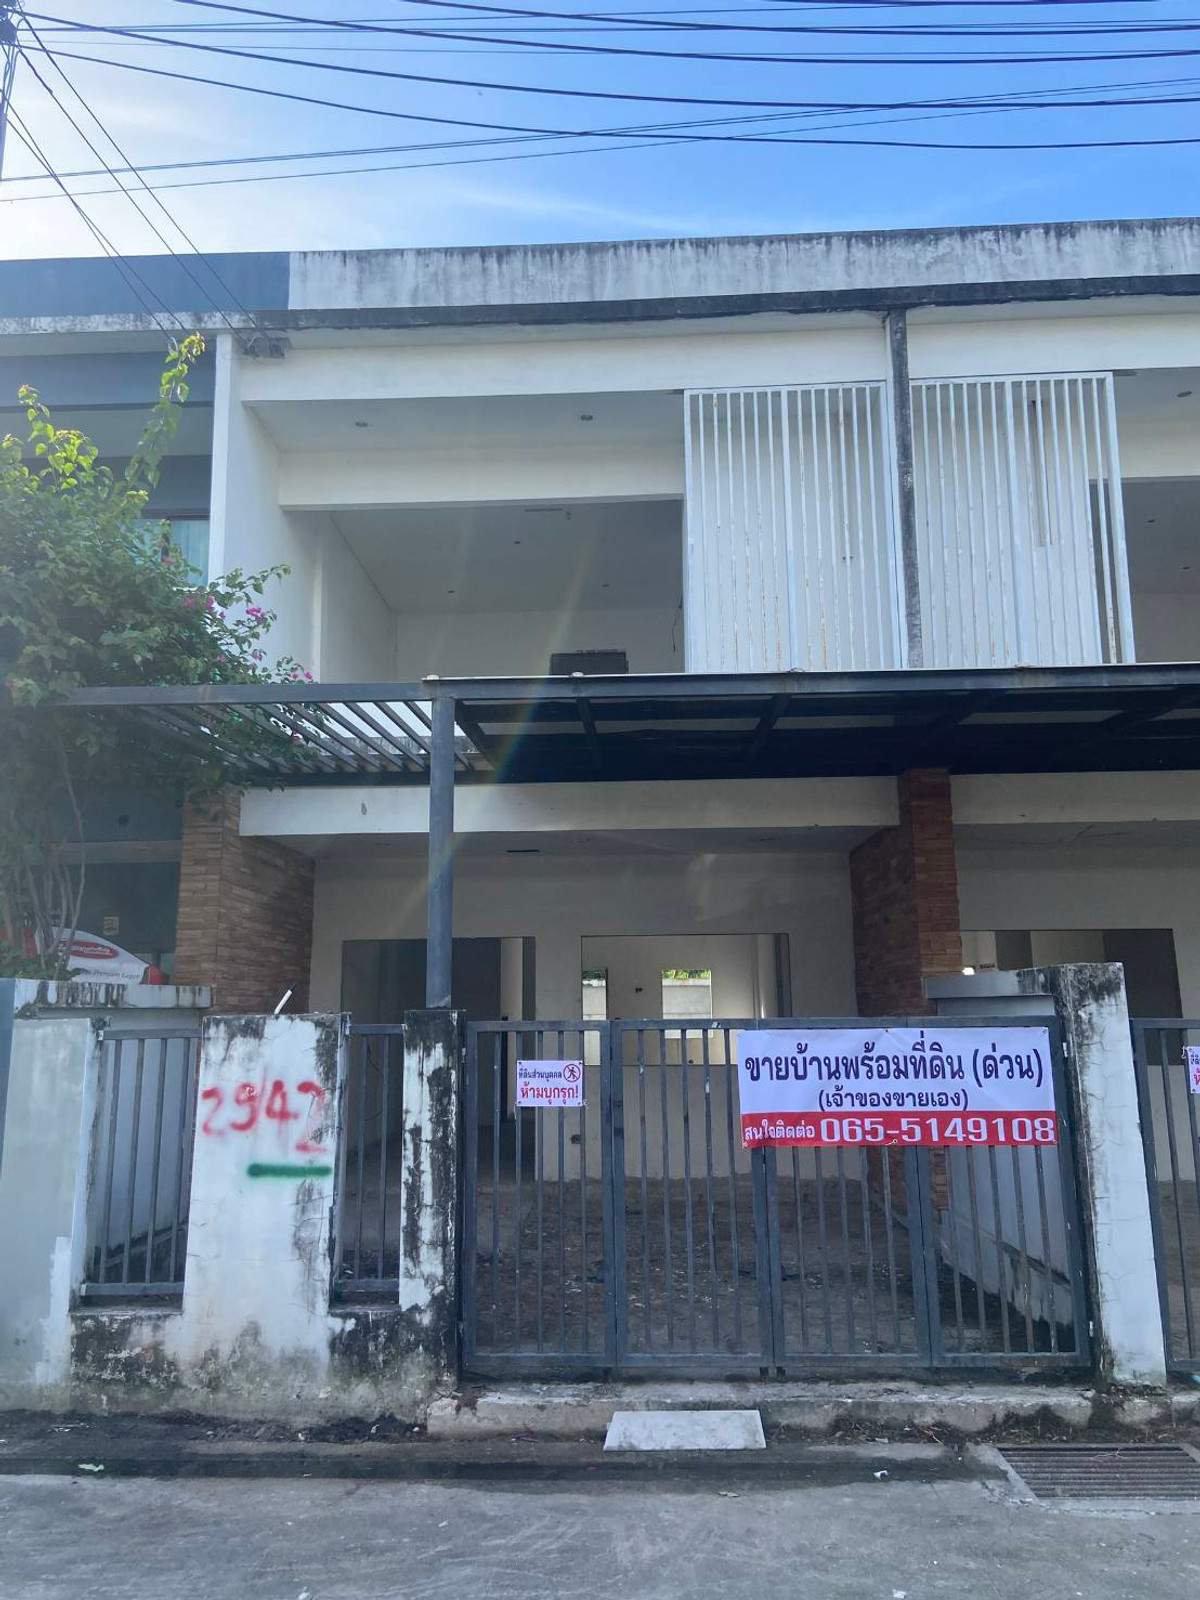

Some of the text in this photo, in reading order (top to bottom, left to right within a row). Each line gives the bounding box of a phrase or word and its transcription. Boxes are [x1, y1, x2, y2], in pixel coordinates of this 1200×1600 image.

[745, 1031, 1043, 1087] ขายบ้านพร้อมที่ดิน (ด่วน)
[520, 1081, 579, 1105] ห้ามบุกรุก!
[818, 1085, 969, 1111] (เจ้าของขายเอง)
[744, 1117, 1055, 1142] สนใจติดต่อ 065-5149108
